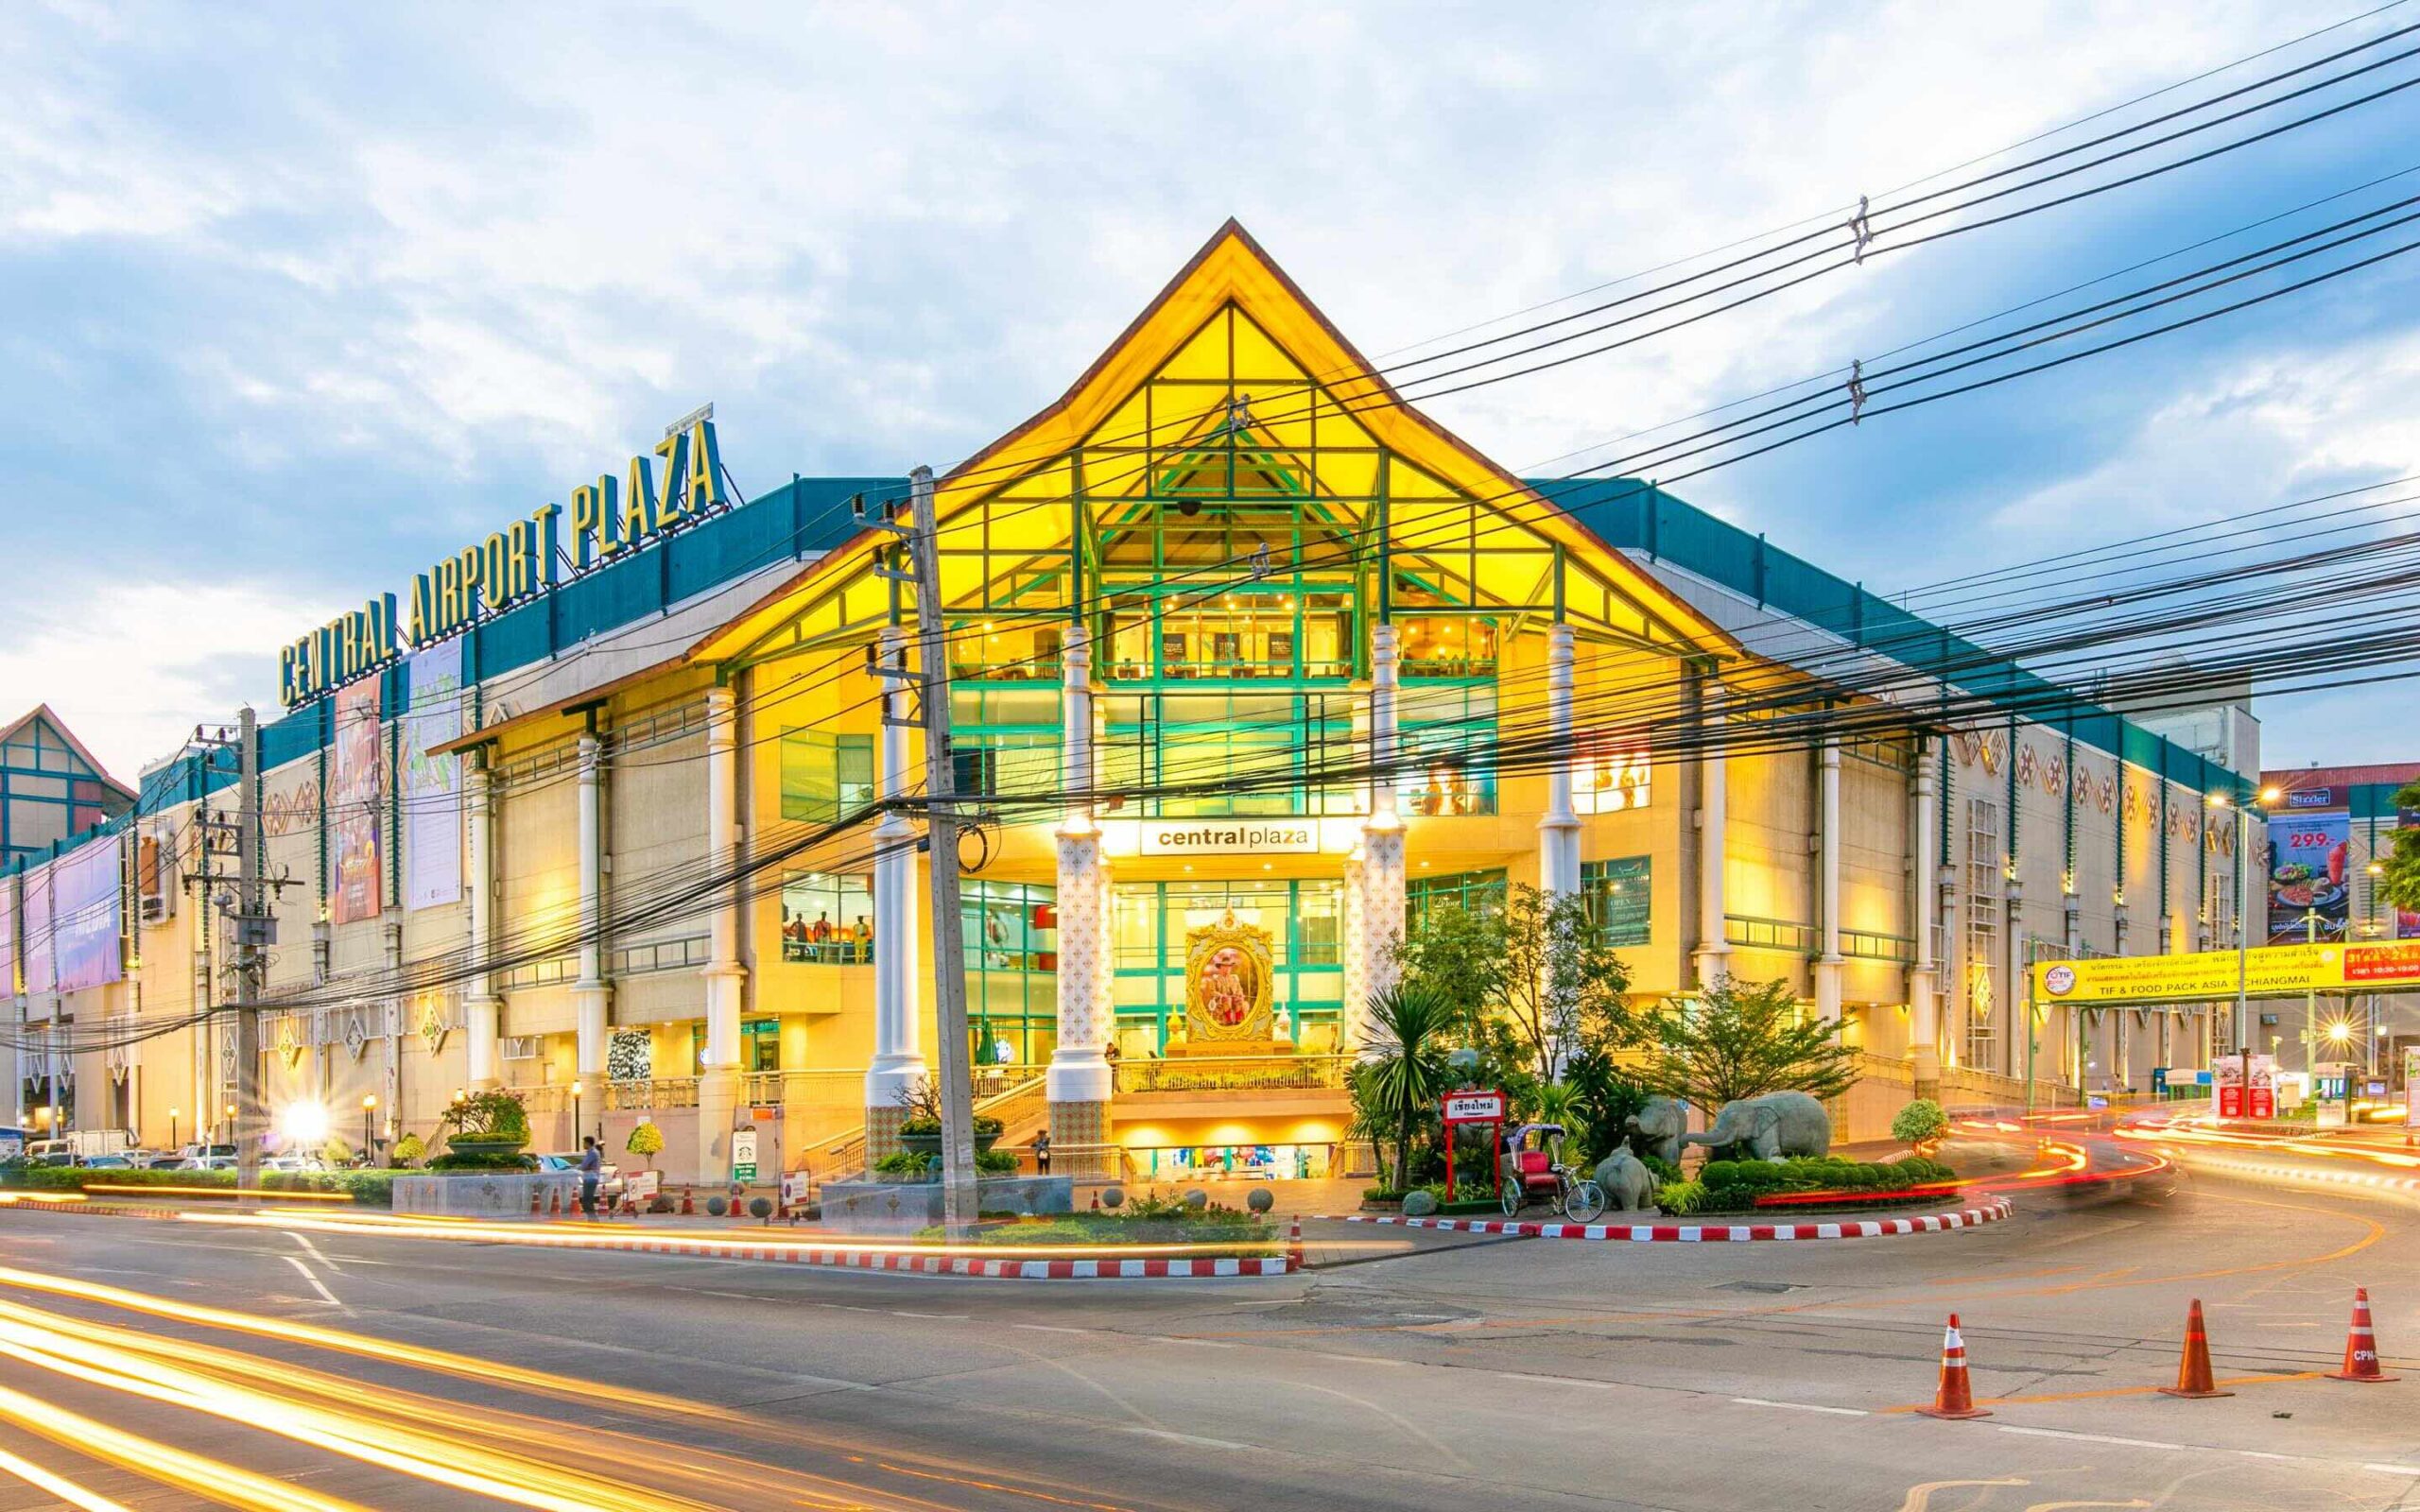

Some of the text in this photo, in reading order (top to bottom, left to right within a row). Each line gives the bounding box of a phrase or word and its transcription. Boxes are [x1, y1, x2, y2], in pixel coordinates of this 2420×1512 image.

[278, 420, 725, 707] CENTRAL AIRPORT PLAZA
[2291, 794, 2327, 804] Sizzler
[2100, 987, 2115, 995] TIF
[2131, 985, 2162, 993] FOOD
[2167, 982, 2197, 991] PACK
[2203, 980, 2228, 989] ASIA
